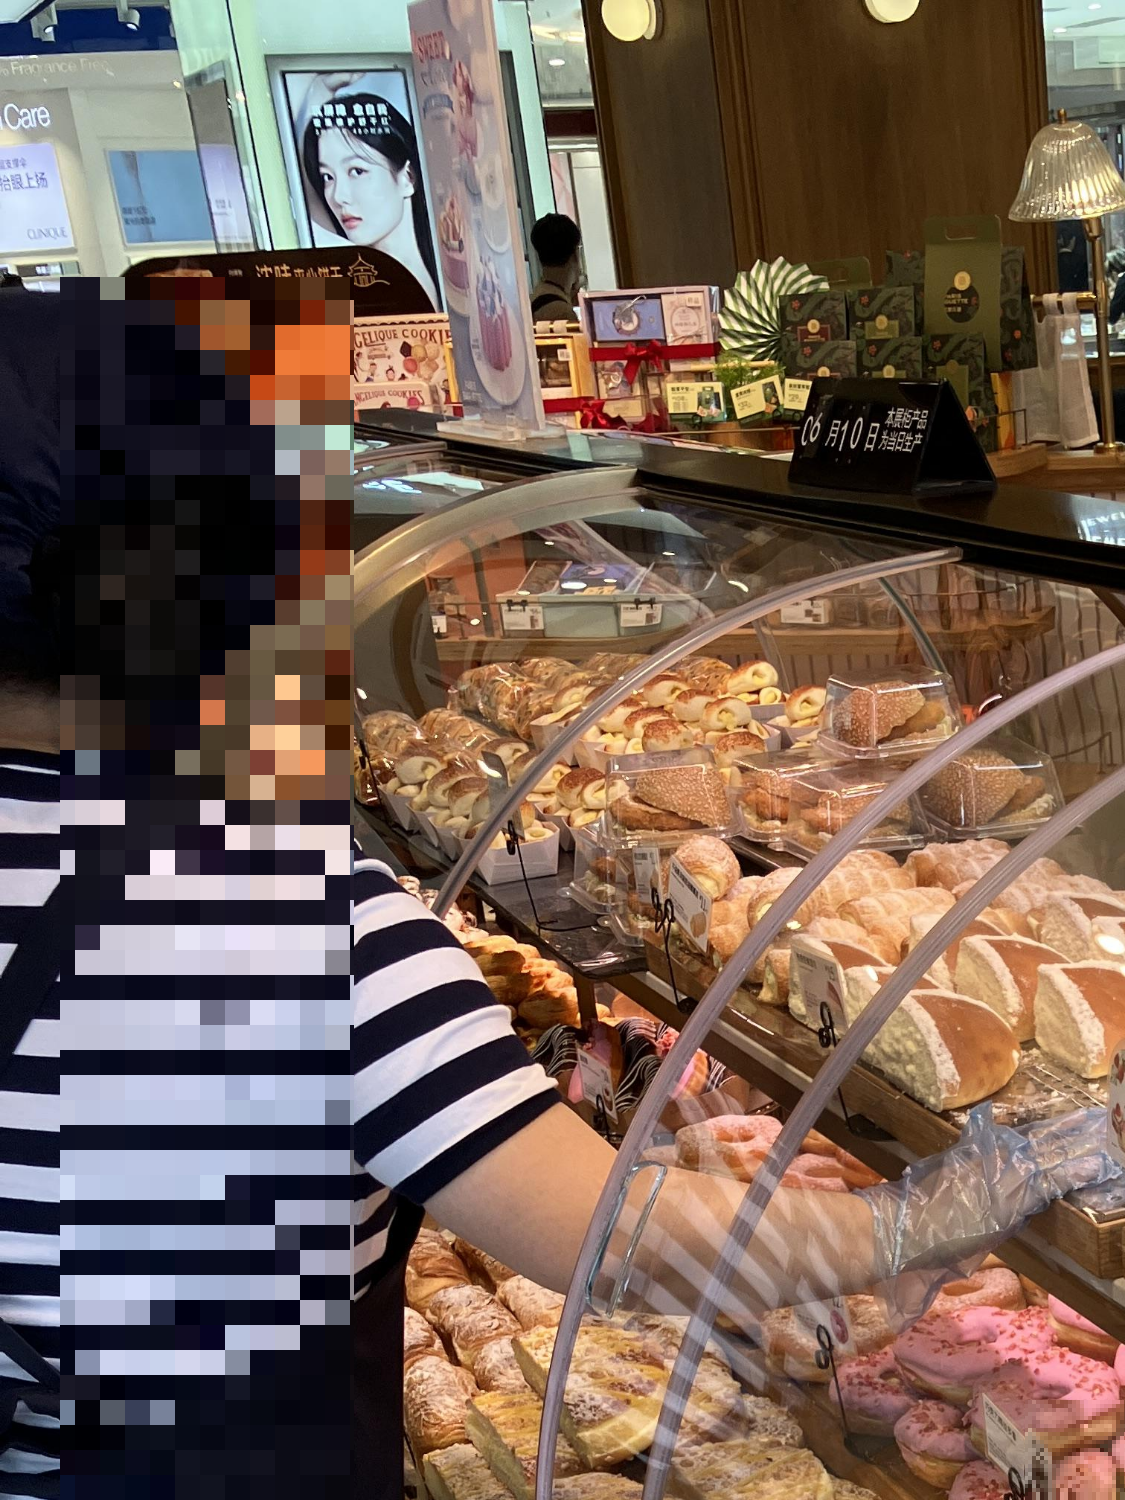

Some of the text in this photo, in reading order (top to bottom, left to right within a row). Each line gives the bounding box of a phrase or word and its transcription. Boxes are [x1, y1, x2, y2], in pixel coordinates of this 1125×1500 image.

[4, 103, 50, 131] Care
[26, 226, 68, 241] CLINIQUE
[354, 328, 452, 348] GELIQUE COOKIE
[885, 407, 929, 430] 本展柜产品
[877, 429, 924, 453] 为当日生产
